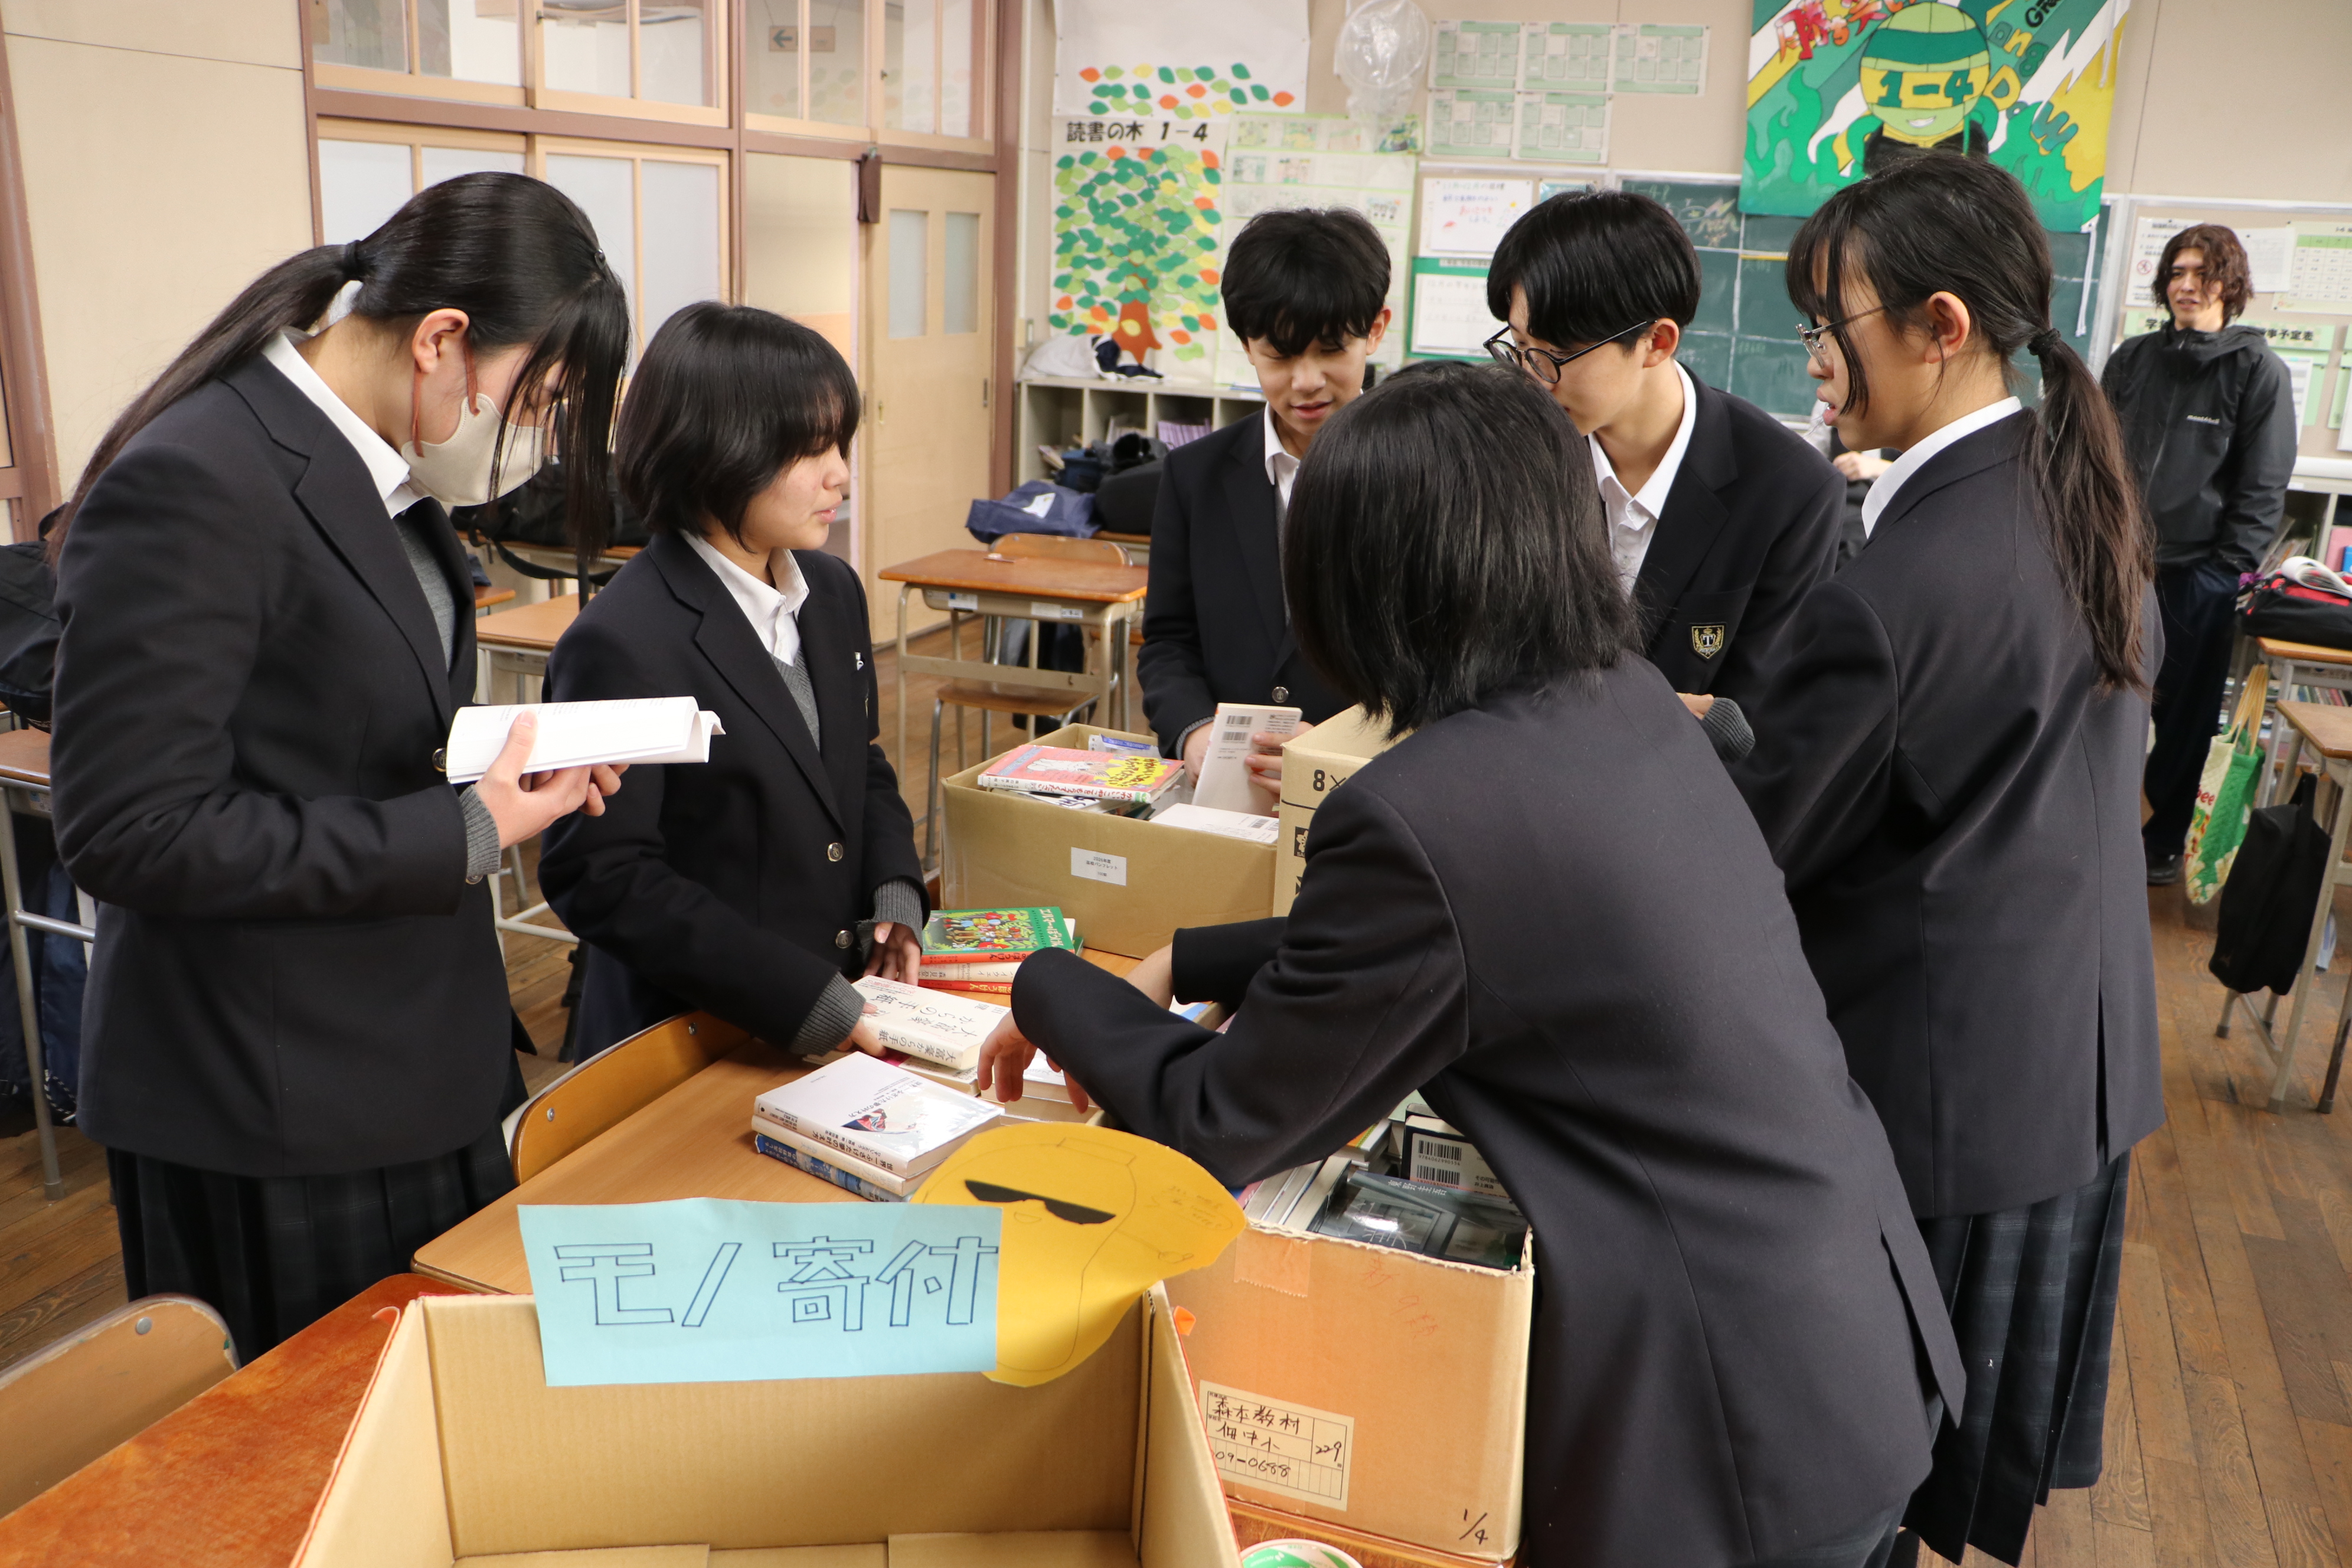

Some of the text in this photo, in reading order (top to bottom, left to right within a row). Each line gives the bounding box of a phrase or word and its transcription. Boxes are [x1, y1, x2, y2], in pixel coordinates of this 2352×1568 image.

[1877, 70, 1974, 108] 1-4
[1066, 120, 1208, 142] 読書の木 1-4
[1108, 757, 1143, 785] もらってください
[1086, 860, 1118, 870] 高校パンフレット
[989, 952, 1028, 962] のぼうけん
[969, 982, 1012, 994] のぼうけん
[869, 992, 976, 1024] からの手紙
[975, 1002, 1007, 1015] 田健
[907, 1016, 978, 1037] 大富豪
[878, 1028, 957, 1063] 大富豪からの手紙
[811, 1129, 894, 1172] 世界一ふざけた夢の叶え方
[1417, 1154, 1461, 1167] 9784062990554
[1387, 1179, 1448, 1196] 東野圭吾
[1315, 1440, 1342, 1462] 229
[1213, 1451, 1291, 1477] 09-0688
[1458, 1507, 1489, 1546] 1/4
